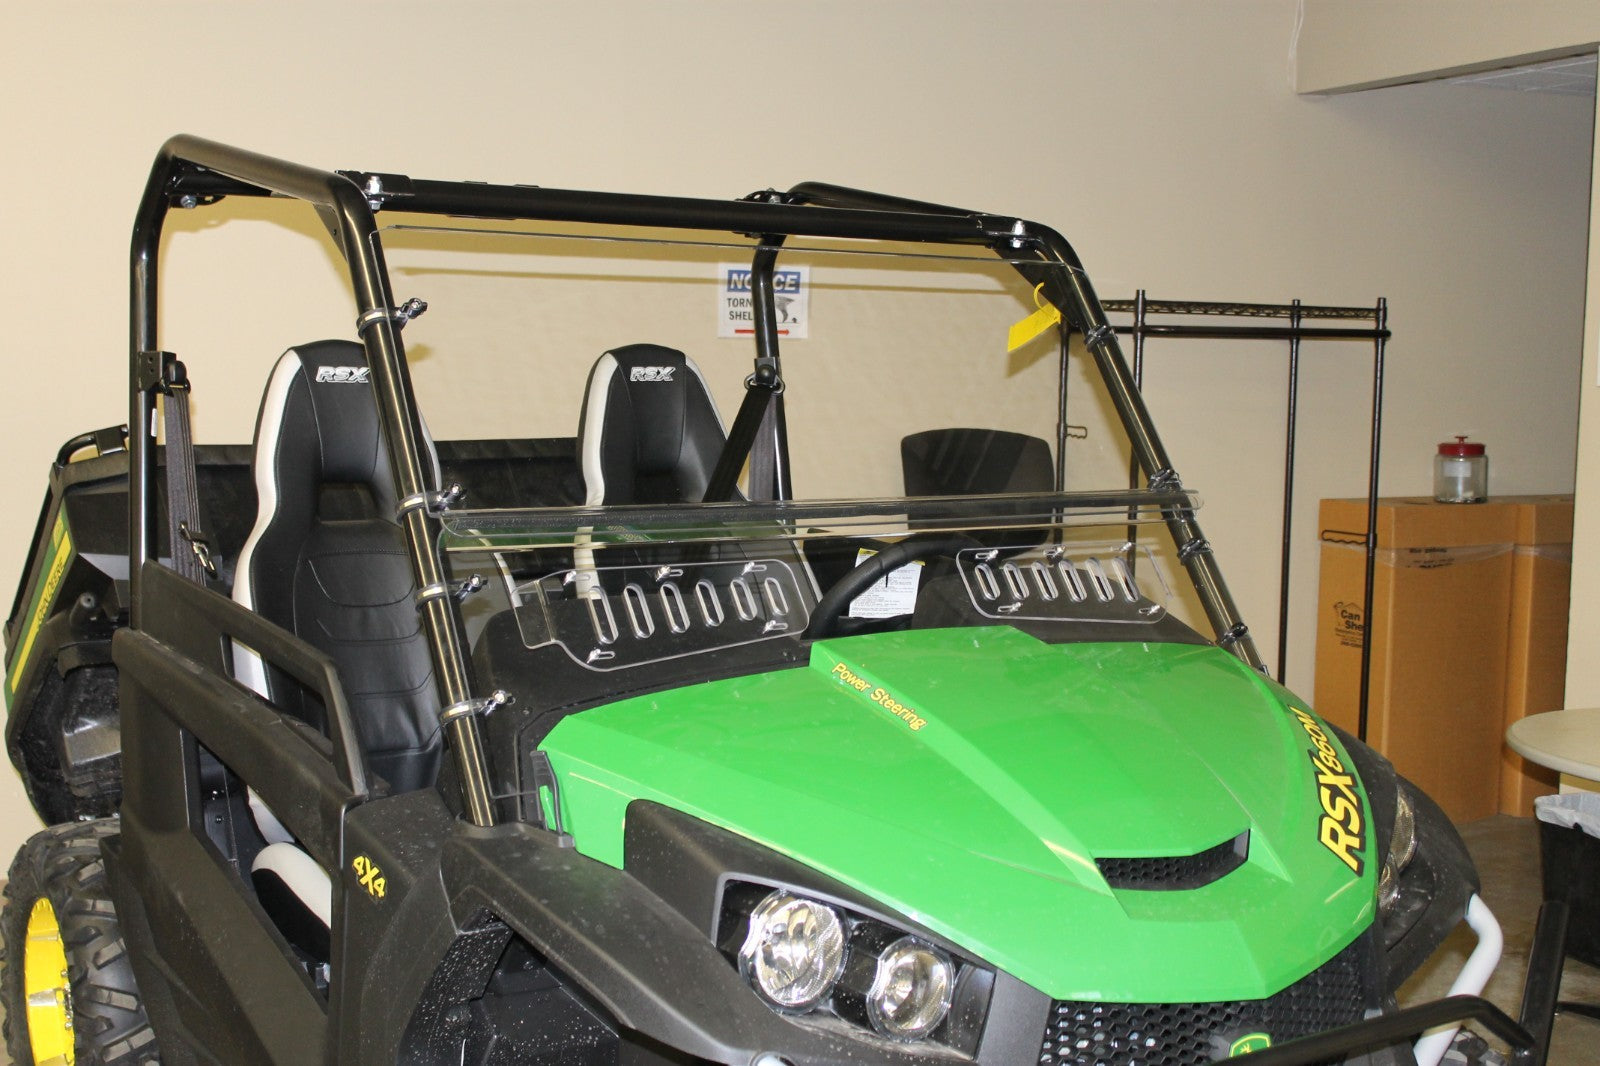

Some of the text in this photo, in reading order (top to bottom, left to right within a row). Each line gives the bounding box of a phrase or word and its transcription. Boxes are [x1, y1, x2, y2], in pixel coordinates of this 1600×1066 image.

[730, 273, 798, 291] NOCE
[316, 365, 371, 384] RSX
[630, 366, 676, 382] RSX
[1341, 609, 1361, 621] Can
[1345, 620, 1364, 632] She
[832, 662, 928, 732] Power Steering
